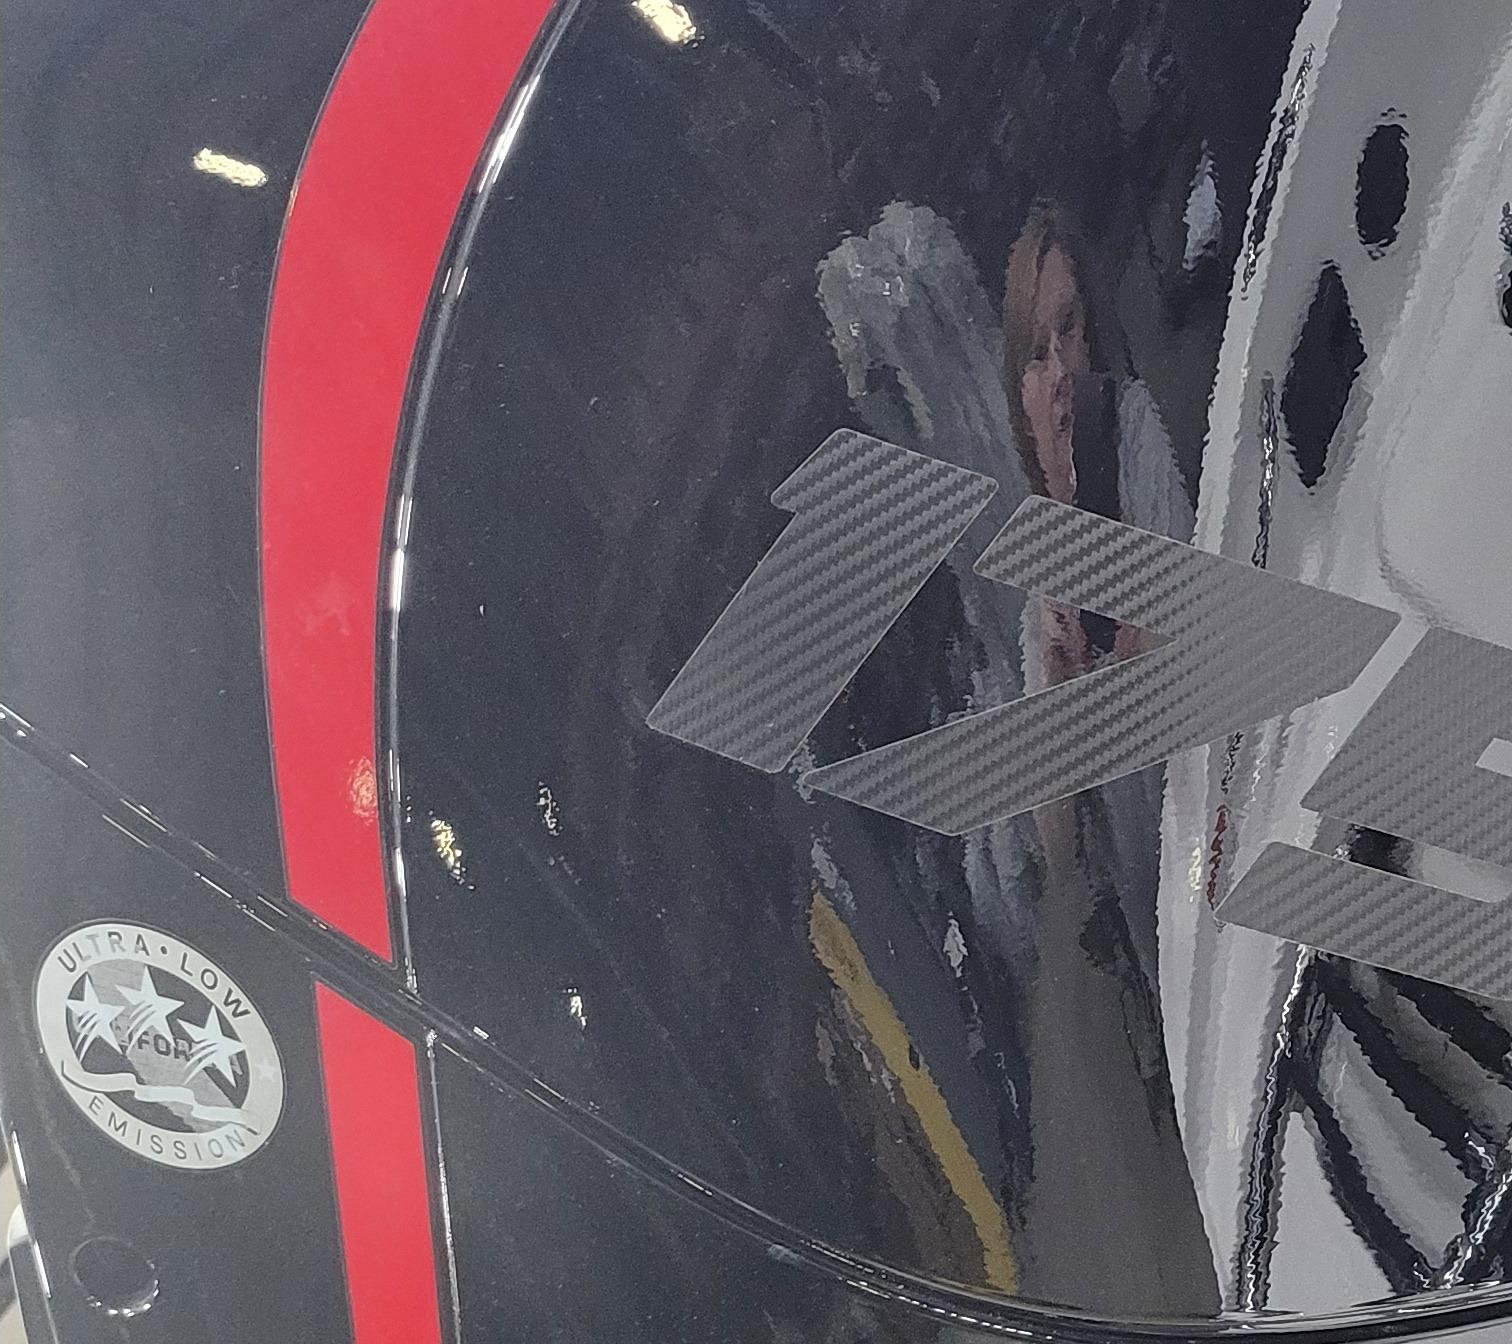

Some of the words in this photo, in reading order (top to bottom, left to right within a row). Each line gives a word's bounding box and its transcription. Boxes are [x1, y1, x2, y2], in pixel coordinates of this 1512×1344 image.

[56, 930, 150, 974] ULTRA
[179, 951, 252, 1020] LOW
[88, 1094, 247, 1161] EMISSION
